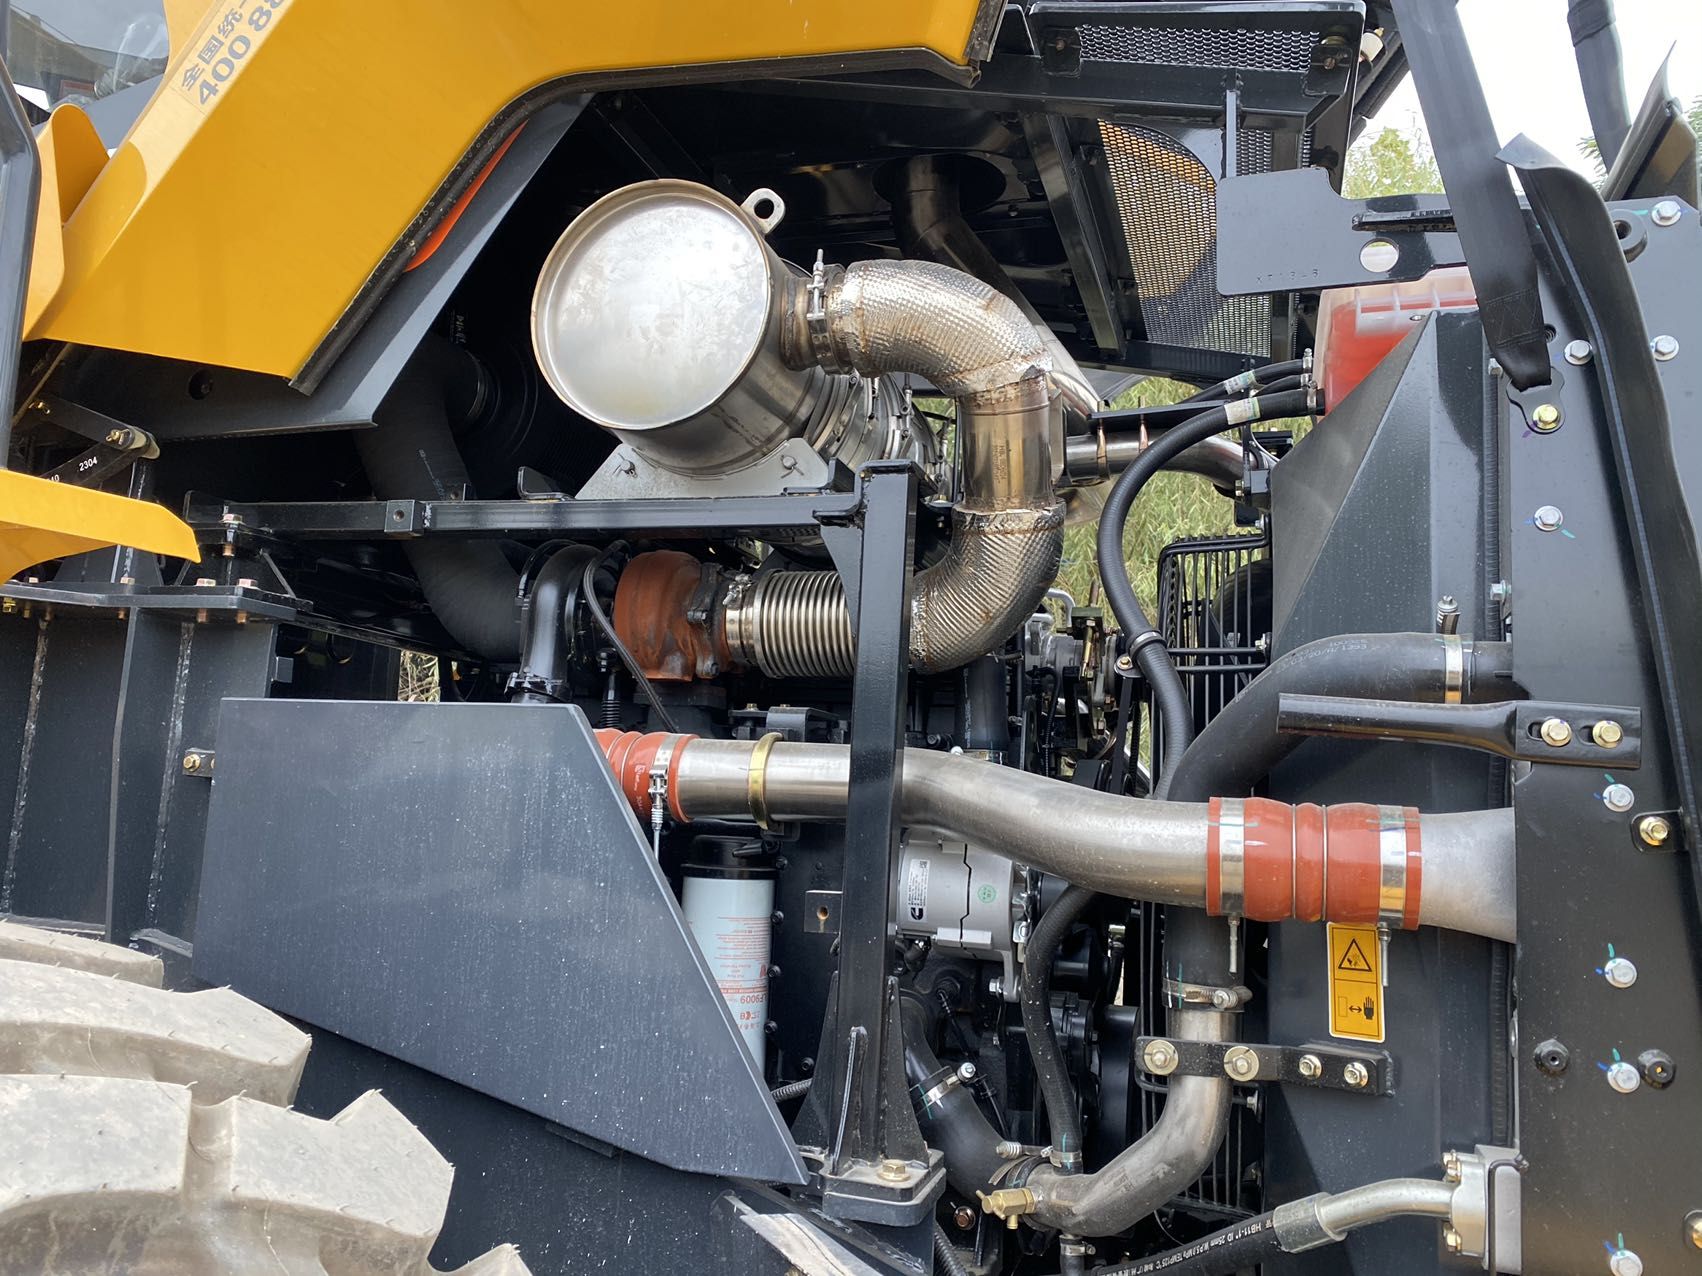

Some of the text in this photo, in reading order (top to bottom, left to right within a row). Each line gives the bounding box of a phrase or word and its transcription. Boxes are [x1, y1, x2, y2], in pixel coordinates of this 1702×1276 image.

[199, 35, 251, 105] 400
[79, 456, 98, 472] 2304
[1227, 1232, 1234, 1242] ID
